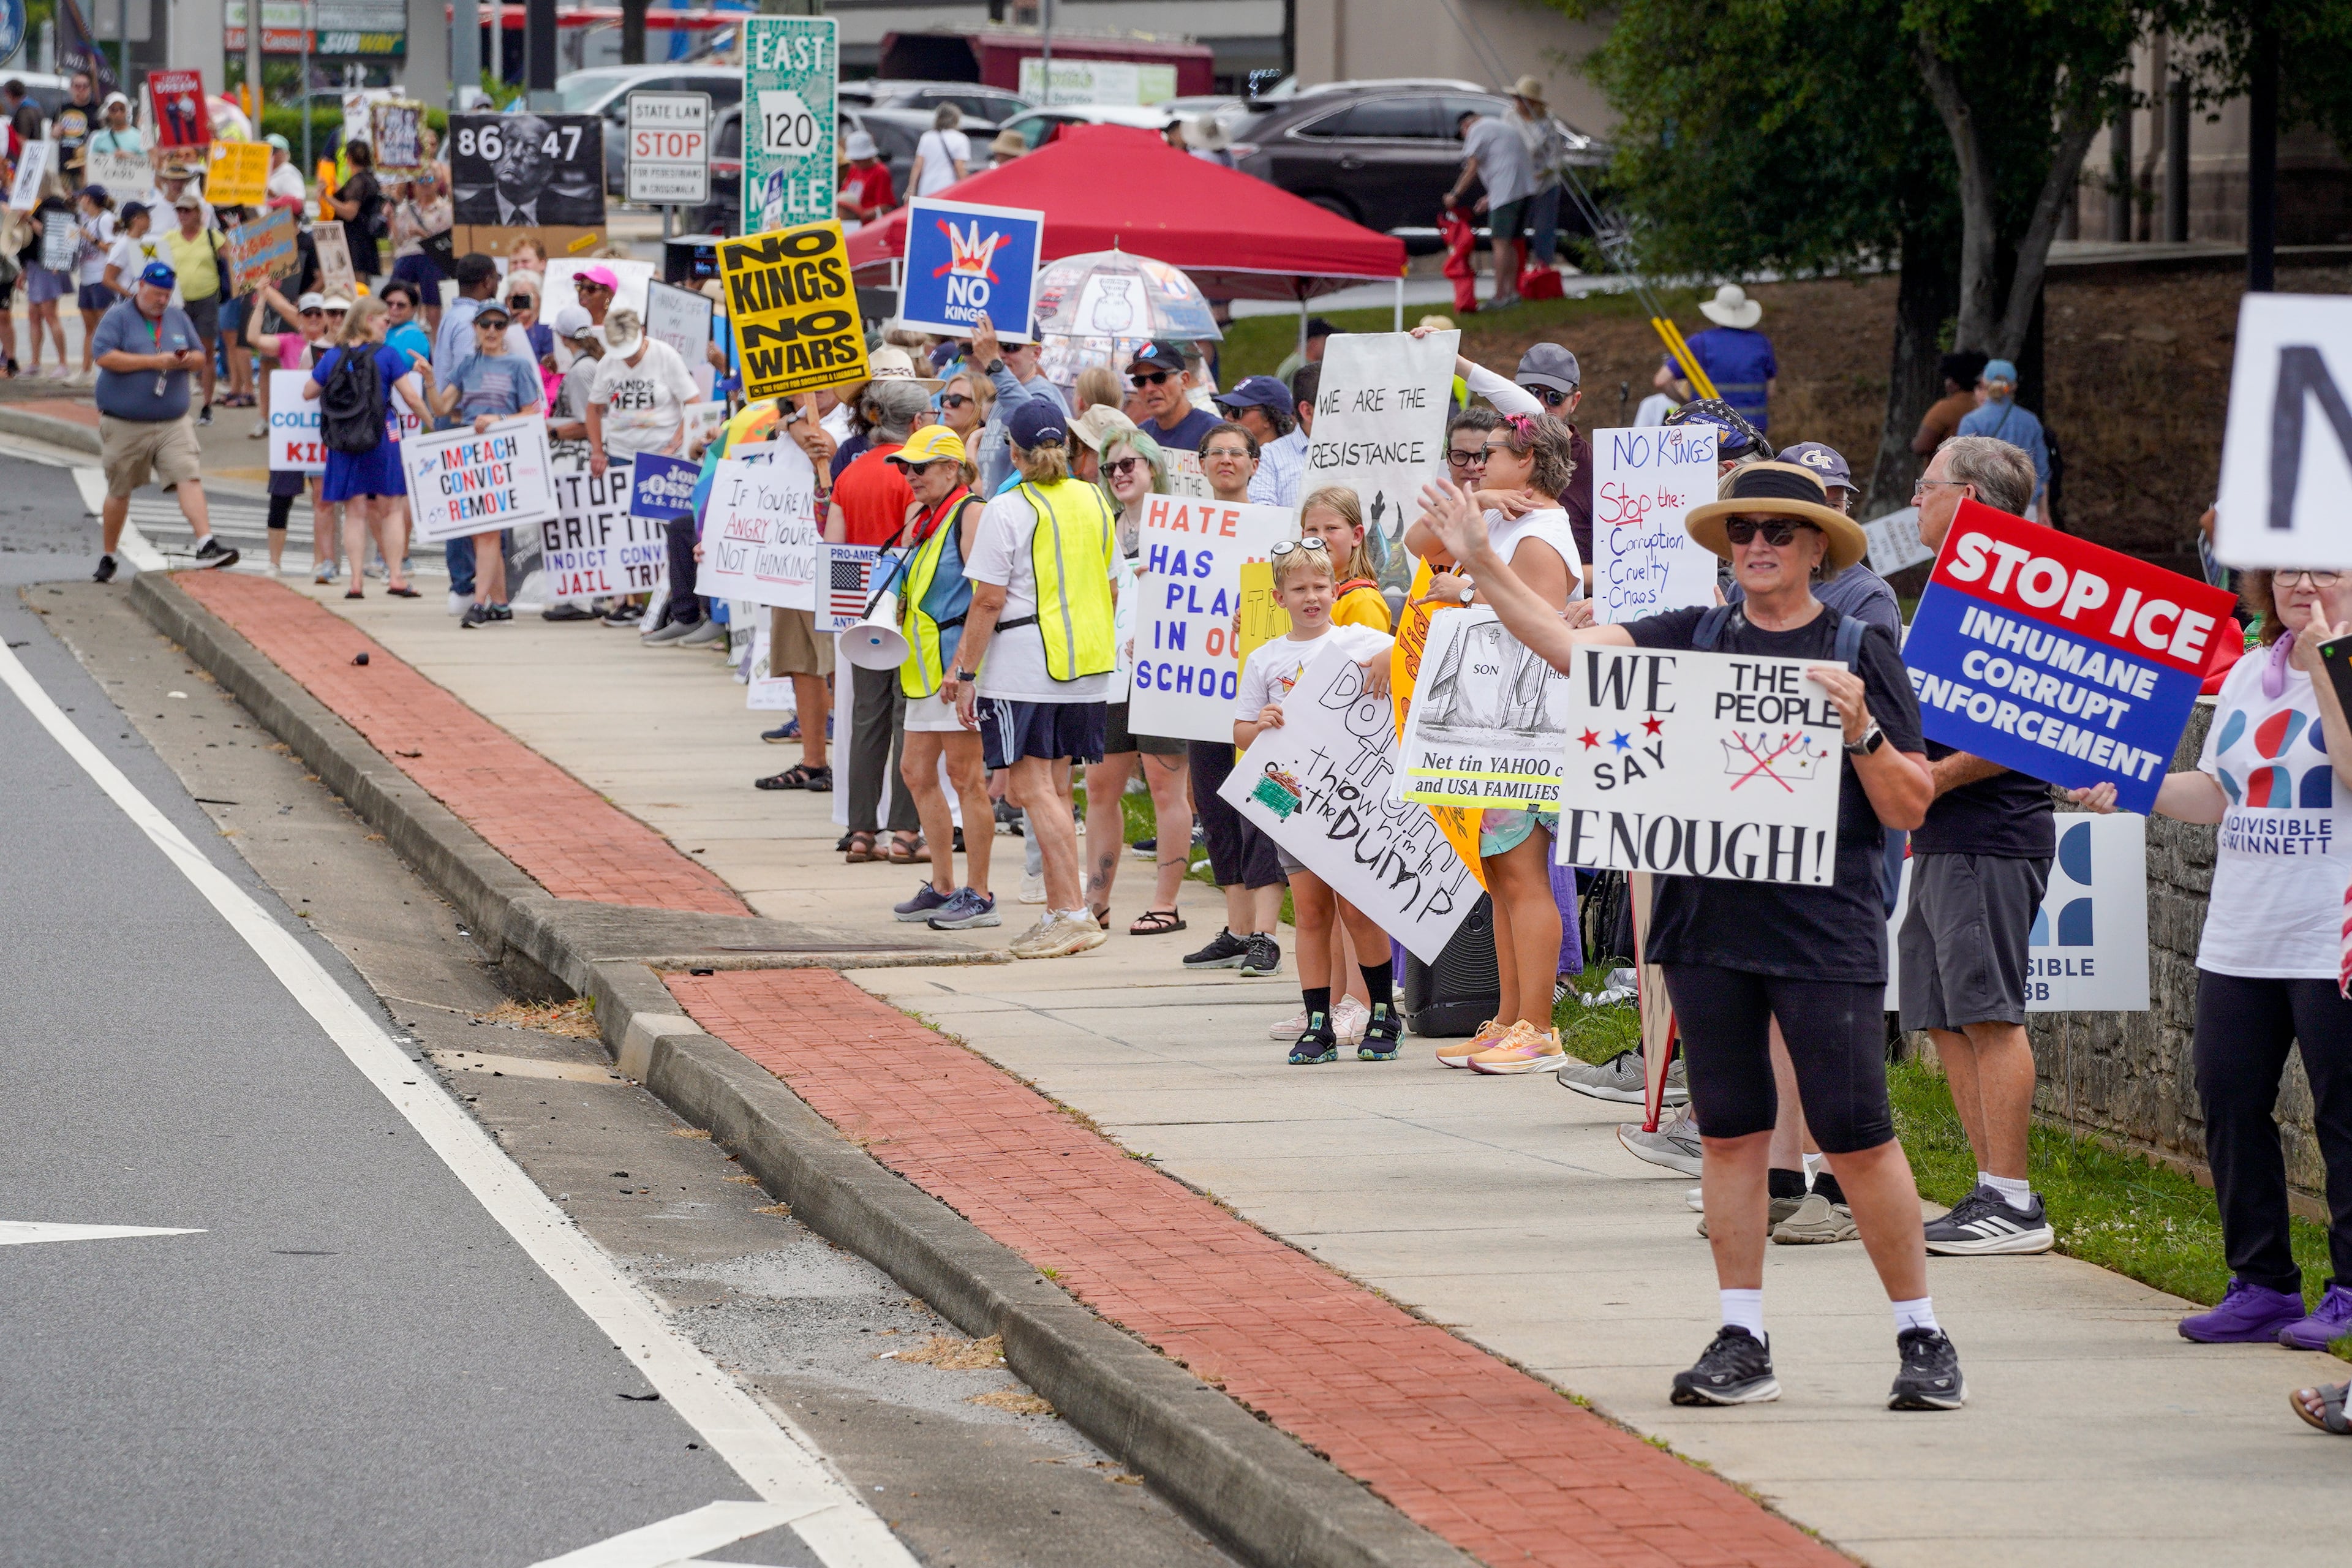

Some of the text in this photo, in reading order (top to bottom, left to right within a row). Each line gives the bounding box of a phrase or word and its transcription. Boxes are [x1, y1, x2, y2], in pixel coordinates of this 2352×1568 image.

[320, 32, 403, 54] SUBWAY
[755, 32, 825, 72] EAST
[636, 104, 701, 119] STATE LAW
[458, 126, 503, 161] 86
[541, 126, 583, 161] 47
[636, 132, 701, 157] STOP
[764, 112, 813, 148] 120
[749, 178, 827, 214] MLE
[723, 228, 837, 271] NO
[729, 257, 846, 314] KINGS
[947, 276, 990, 307] NO
[741, 309, 852, 350] NO
[746, 334, 858, 379] WARS
[1319, 388, 1426, 417] WE ARE THE
[440, 435, 518, 471] IMPEACH
[1309, 442, 1426, 470] RESISTANCE
[1613, 431, 1649, 470] NO
[1800, 450, 1833, 470] GT
[440, 462, 512, 496] CONVICT
[728, 480, 748, 507] IF
[1185, 477, 1202, 496] THE
[448, 488, 518, 522] REMOVE
[1148, 500, 1240, 538] HATE
[1598, 482, 1686, 530] Stop the:
[545, 549, 606, 571] INDICT
[716, 541, 816, 580] NOT THINKING
[1149, 544, 1214, 579] HAS
[557, 570, 611, 595] JAIL
[1166, 583, 1241, 617] PLA
[1946, 532, 2110, 620] STOP
[2109, 587, 2217, 665] ICE
[1155, 620, 1187, 651] IN
[1959, 606, 2158, 701] INHUMANE
[1473, 664, 1499, 675] SON
[1585, 650, 1676, 713] WE
[1730, 663, 1800, 695] THE
[1961, 650, 2130, 729] CORRUPT
[1715, 692, 1841, 729] PEOPLE
[1905, 666, 2163, 783] ENFORCEMENT
[1422, 752, 1453, 769] Net
[1460, 755, 1482, 772] tin
[1490, 757, 1551, 776] YAHOO
[1594, 740, 1665, 791] SAY
[1305, 786, 1336, 823] the
[1308, 746, 1377, 815] throw
[1378, 818, 1417, 854] him
[1415, 778, 1559, 801] and USA FAMILIES
[1564, 809, 1826, 883] ENOUGH!
